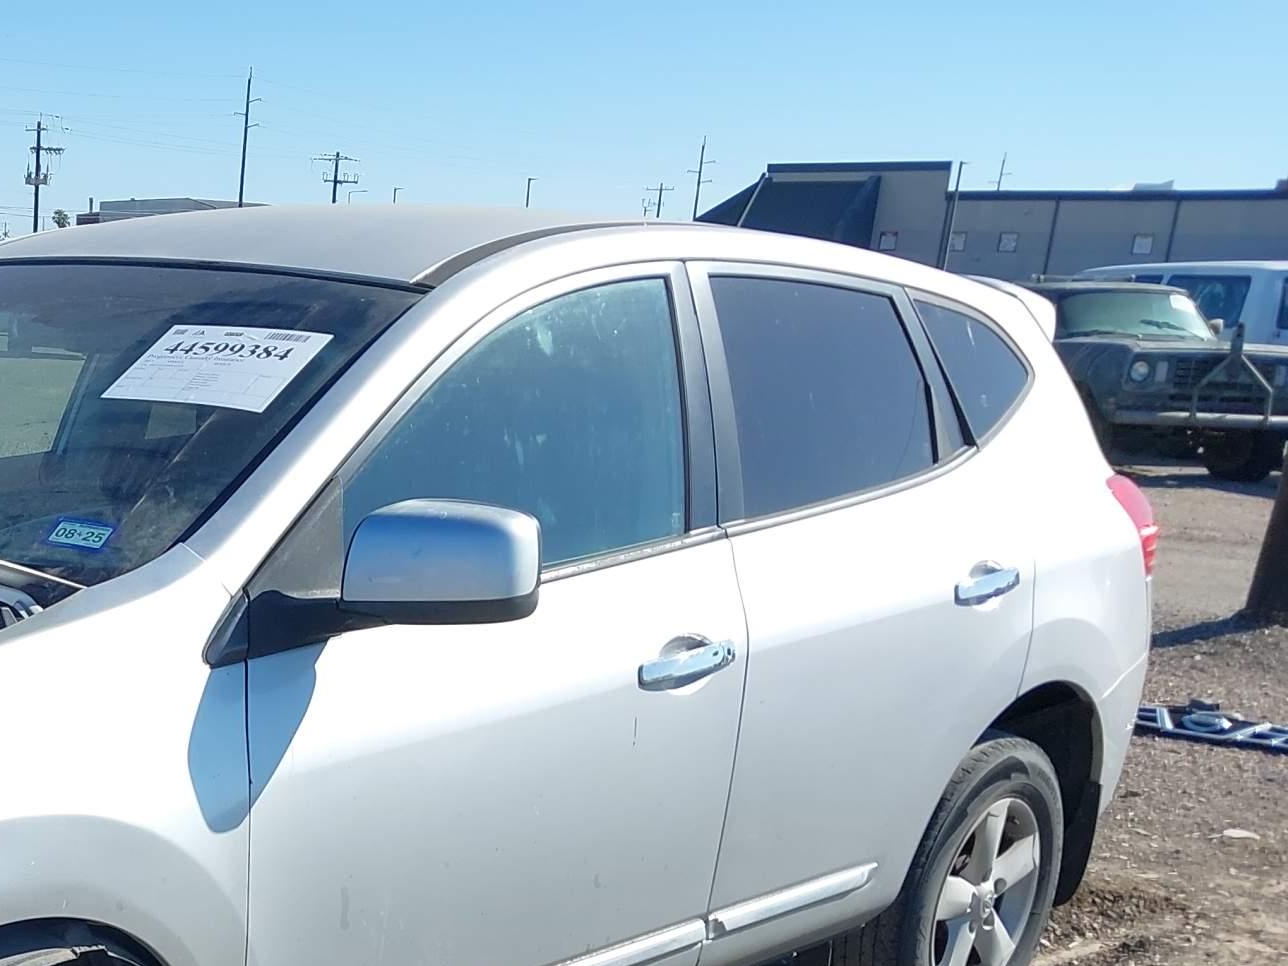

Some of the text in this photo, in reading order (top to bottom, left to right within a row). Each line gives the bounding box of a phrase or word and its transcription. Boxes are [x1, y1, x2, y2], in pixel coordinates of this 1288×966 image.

[164, 340, 294, 360] 44599384
[55, 527, 106, 543] 08 25
